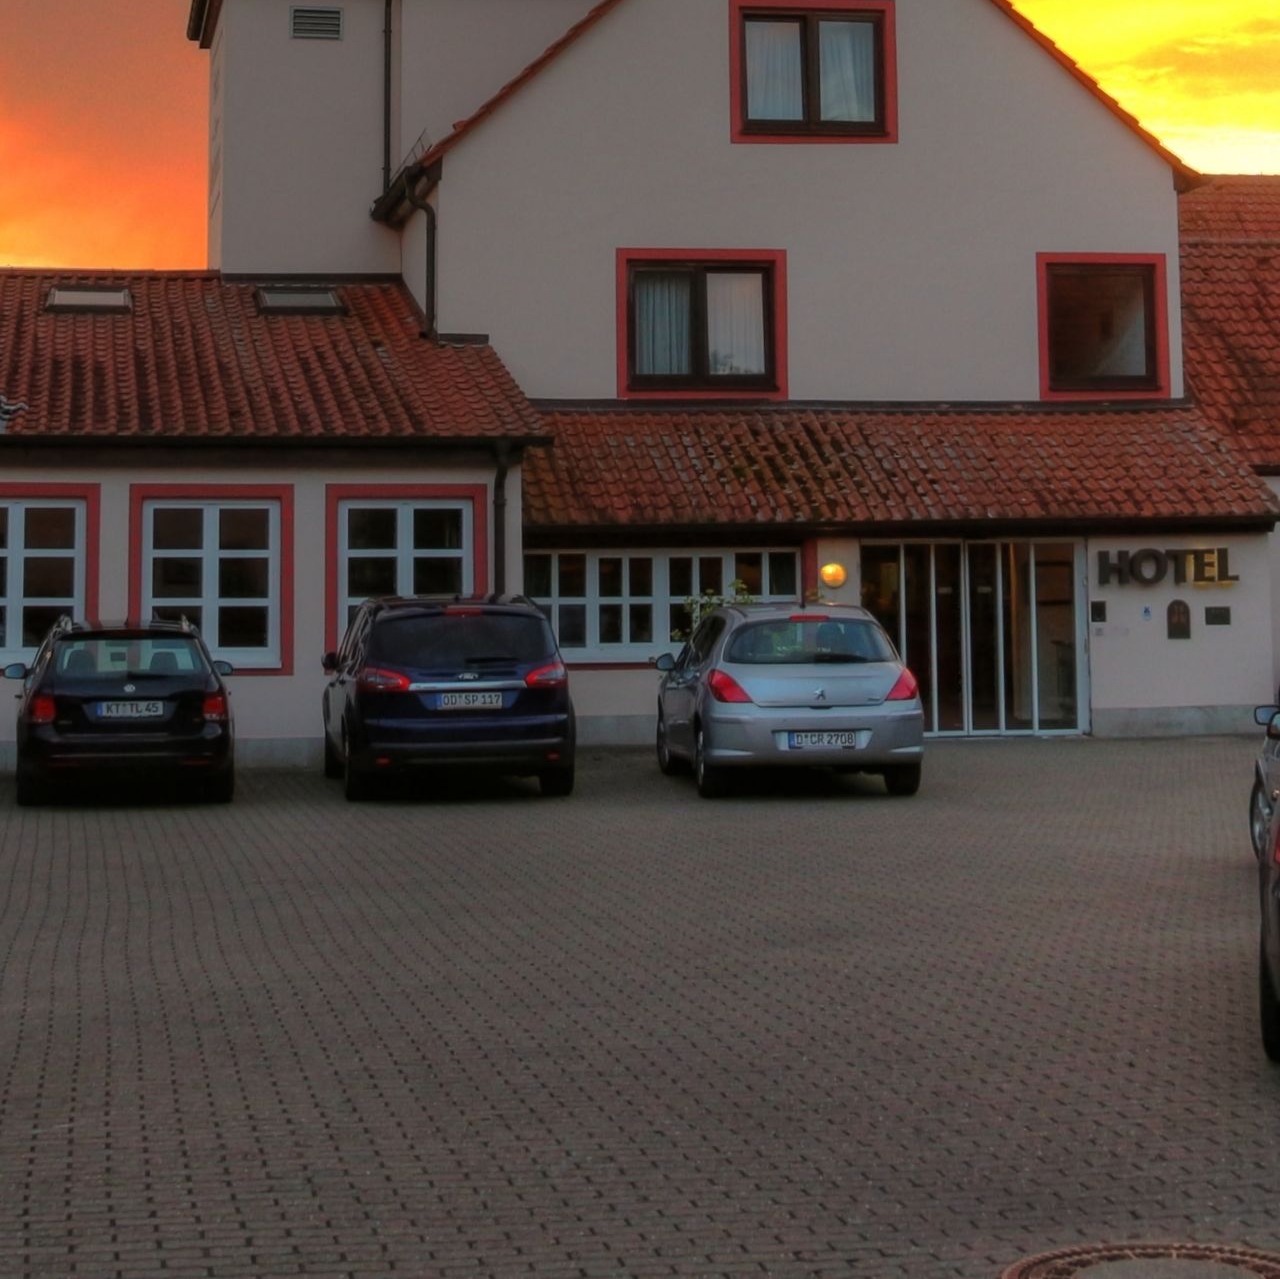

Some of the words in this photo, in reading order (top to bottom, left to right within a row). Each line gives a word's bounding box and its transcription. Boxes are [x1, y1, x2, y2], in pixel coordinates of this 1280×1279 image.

[1097, 547, 1240, 586] HOTEL
[443, 694, 457, 706] OD
[464, 694, 479, 705] SP
[481, 694, 501, 705] 117
[106, 703, 120, 714] KT
[145, 702, 159, 713] 45
[796, 734, 804, 745] D
[810, 733, 824, 745] CR
[826, 733, 854, 745] 2708
